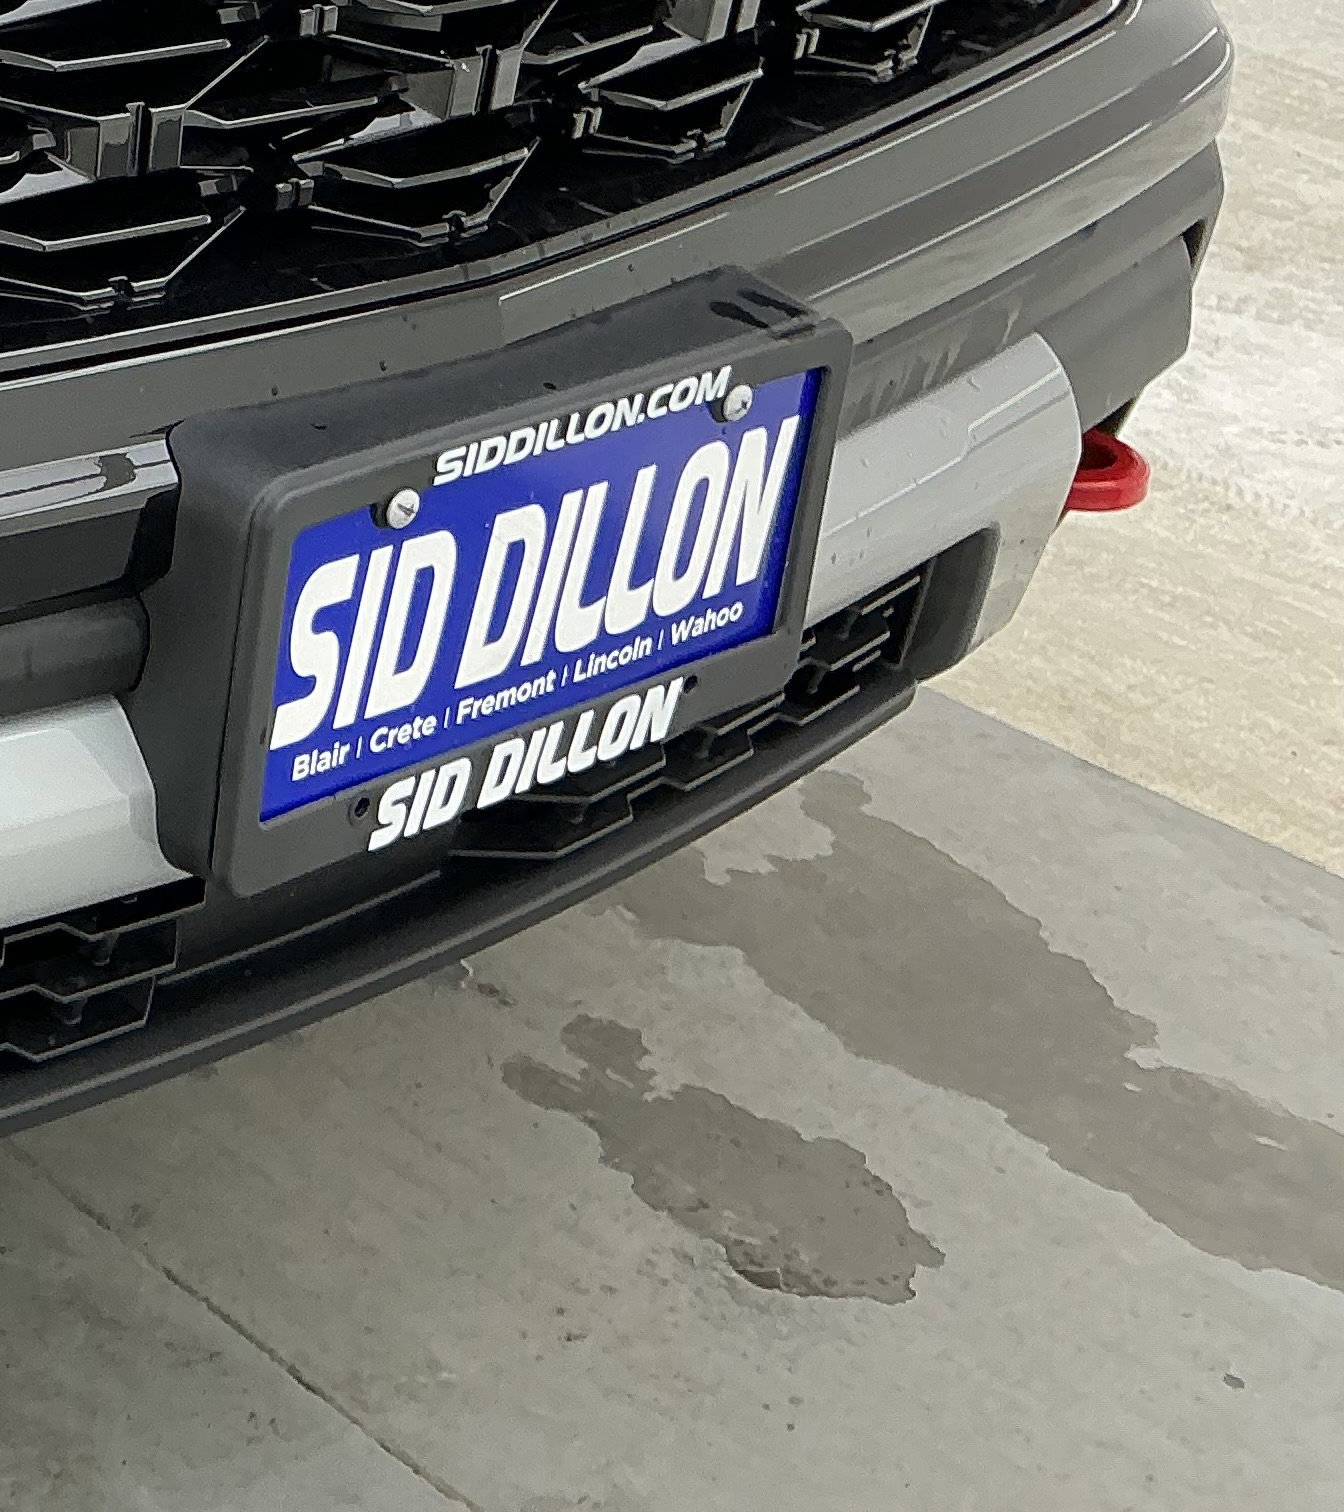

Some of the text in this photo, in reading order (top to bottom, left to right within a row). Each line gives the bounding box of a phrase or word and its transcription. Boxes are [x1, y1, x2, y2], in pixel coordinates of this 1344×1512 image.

[432, 364, 733, 487] SIDDILLON.COM
[269, 414, 801, 751] SID DILLON
[291, 600, 744, 782] Blair Crete Fremont Lincoln Wahoo
[367, 676, 685, 853] SID DILLON
